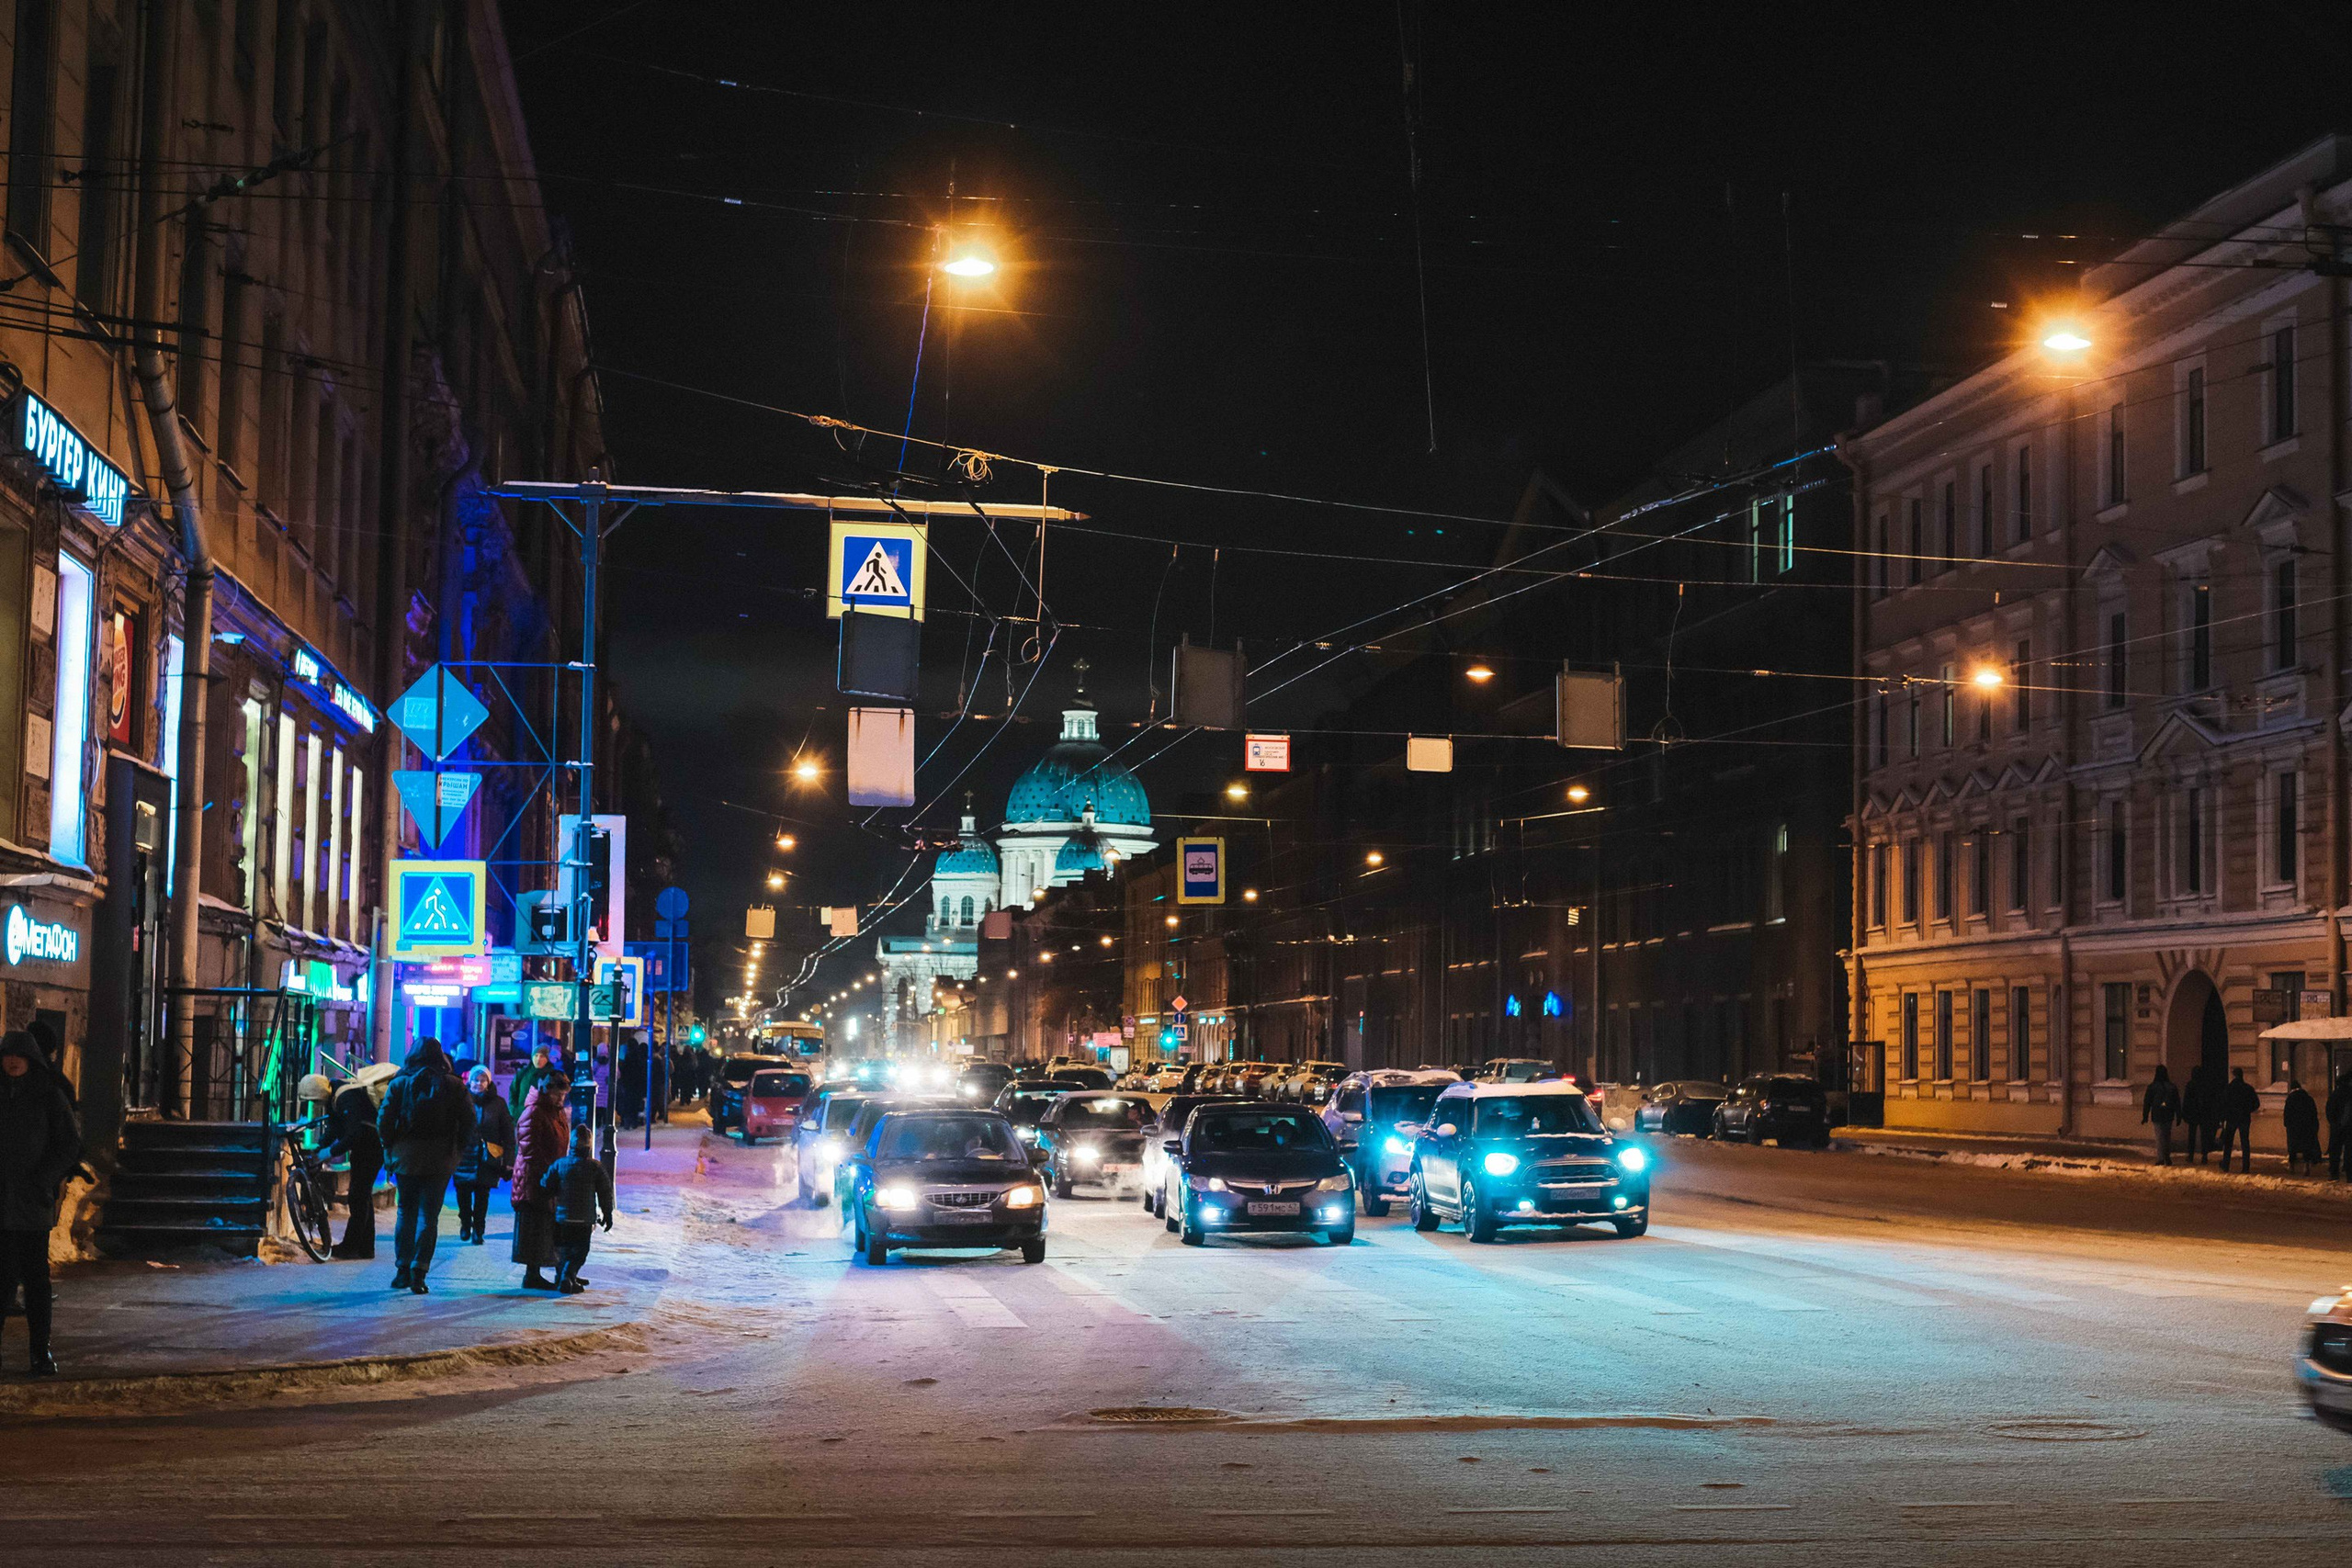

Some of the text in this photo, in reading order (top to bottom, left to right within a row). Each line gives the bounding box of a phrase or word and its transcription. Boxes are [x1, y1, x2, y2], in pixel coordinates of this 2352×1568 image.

[25, 395, 127, 526] БУРГЕР КИНГ
[438, 781, 468, 789] КРЫШАМ
